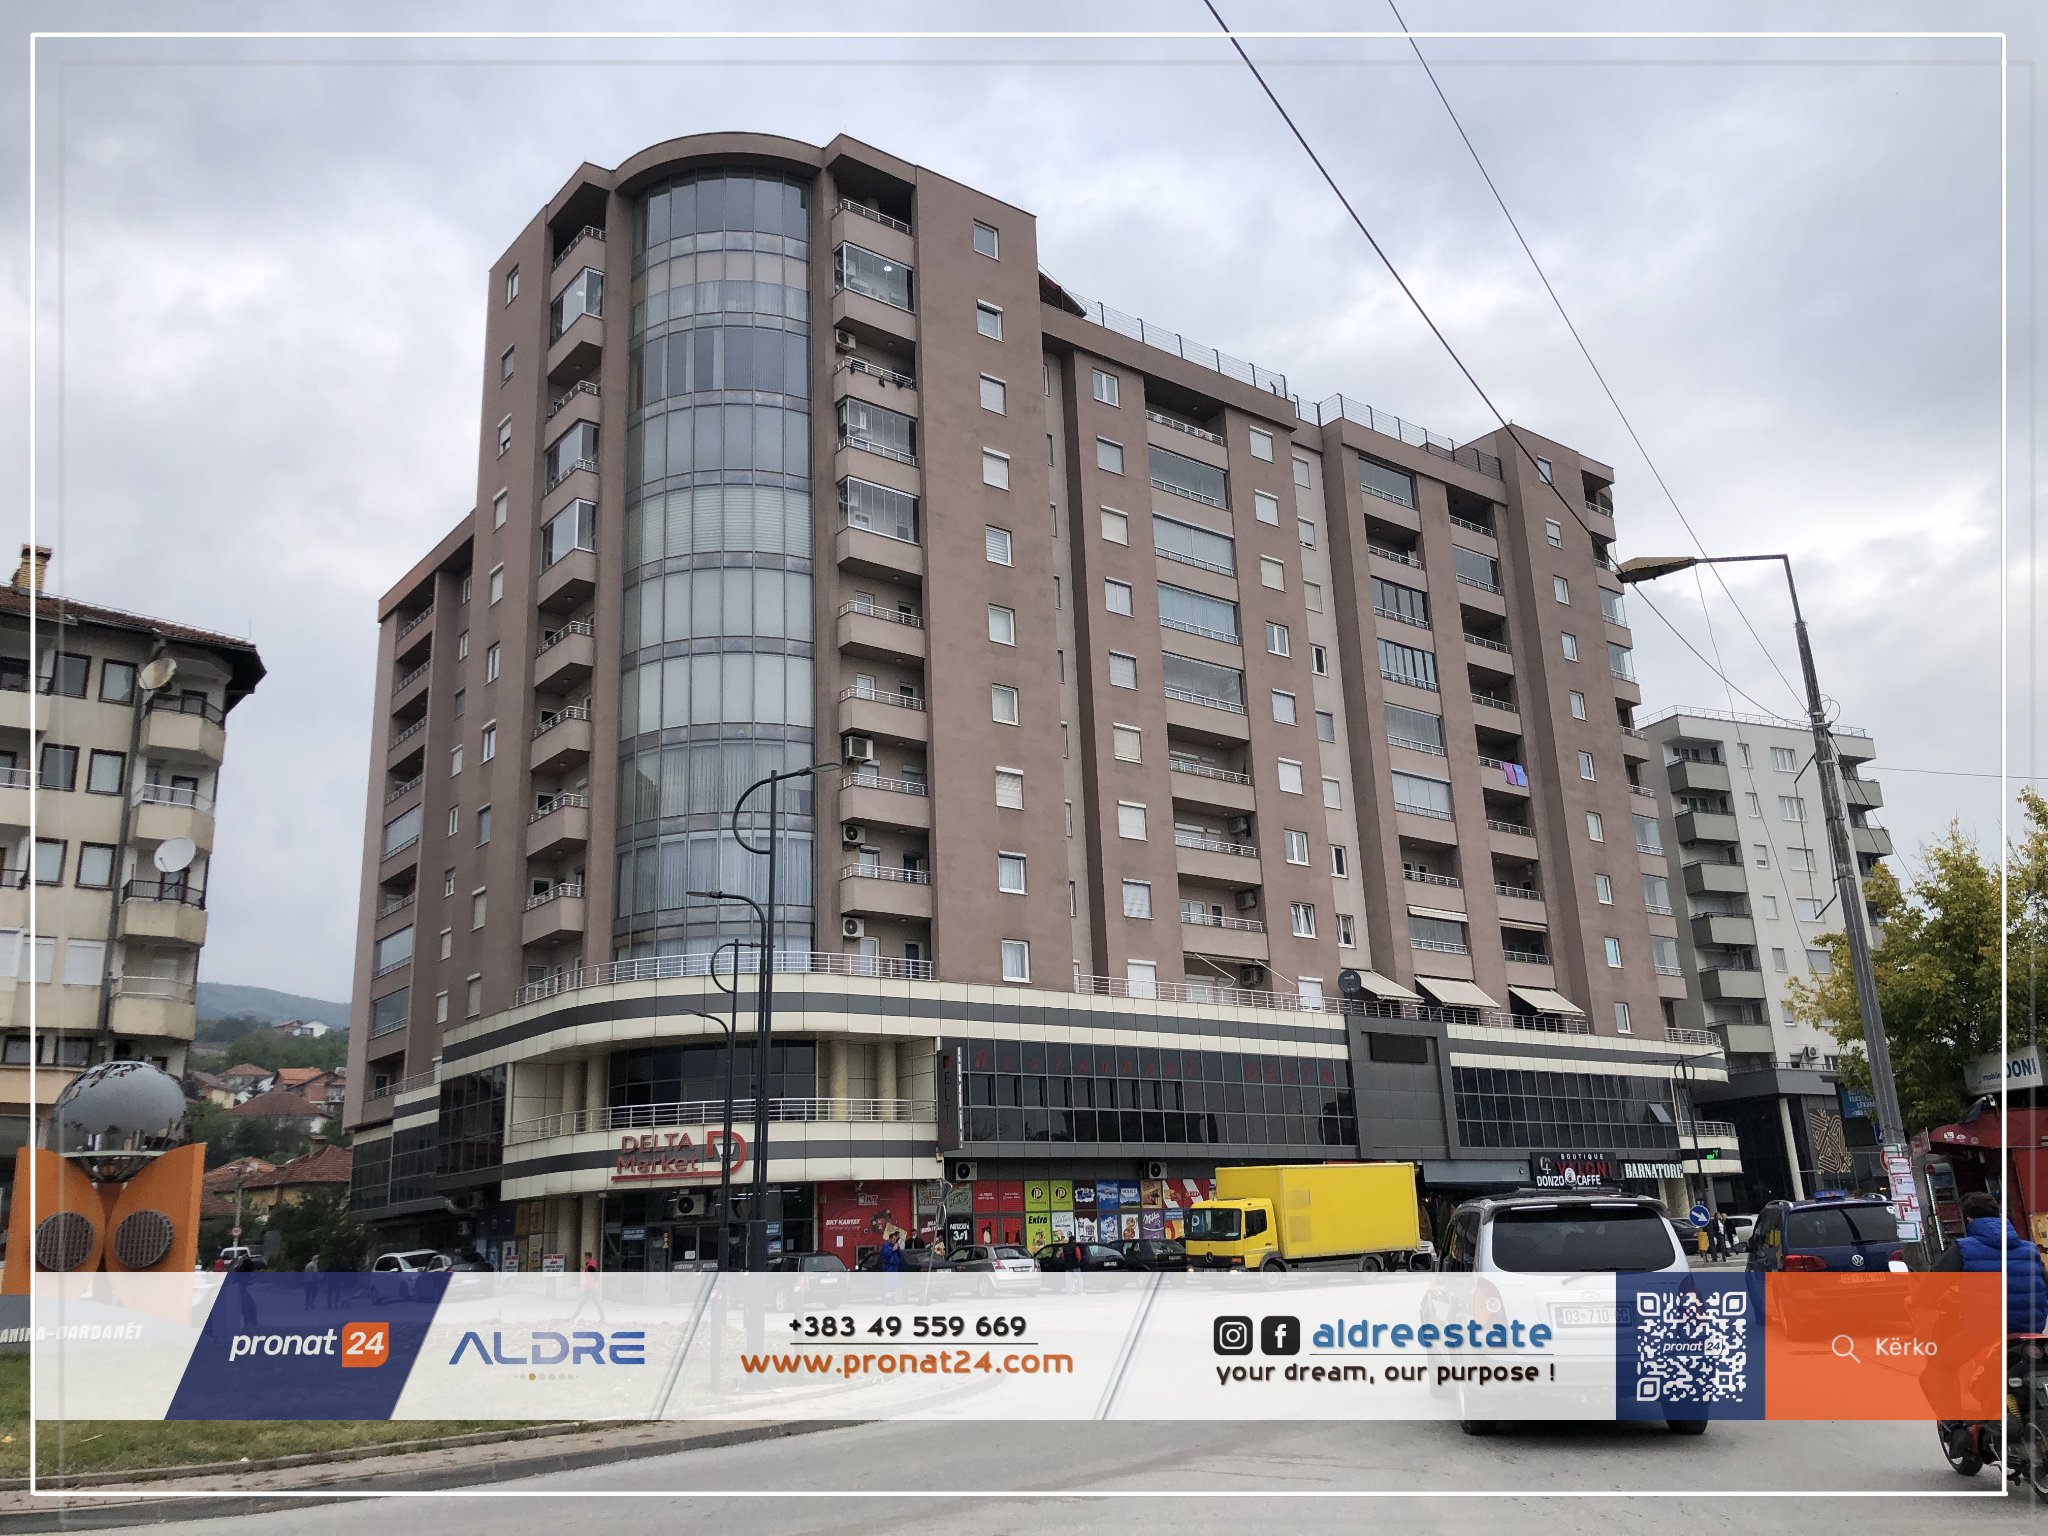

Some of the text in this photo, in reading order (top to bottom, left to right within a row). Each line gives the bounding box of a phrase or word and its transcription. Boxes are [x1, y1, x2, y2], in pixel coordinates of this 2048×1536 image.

[621, 1132, 693, 1154] DELTA
[615, 1153, 699, 1175] Market
[1624, 1163, 1684, 1179] BARNATORE
[1536, 1174, 1602, 1187] DONZO CAFFE
[1028, 1216, 1048, 1225] Extra
